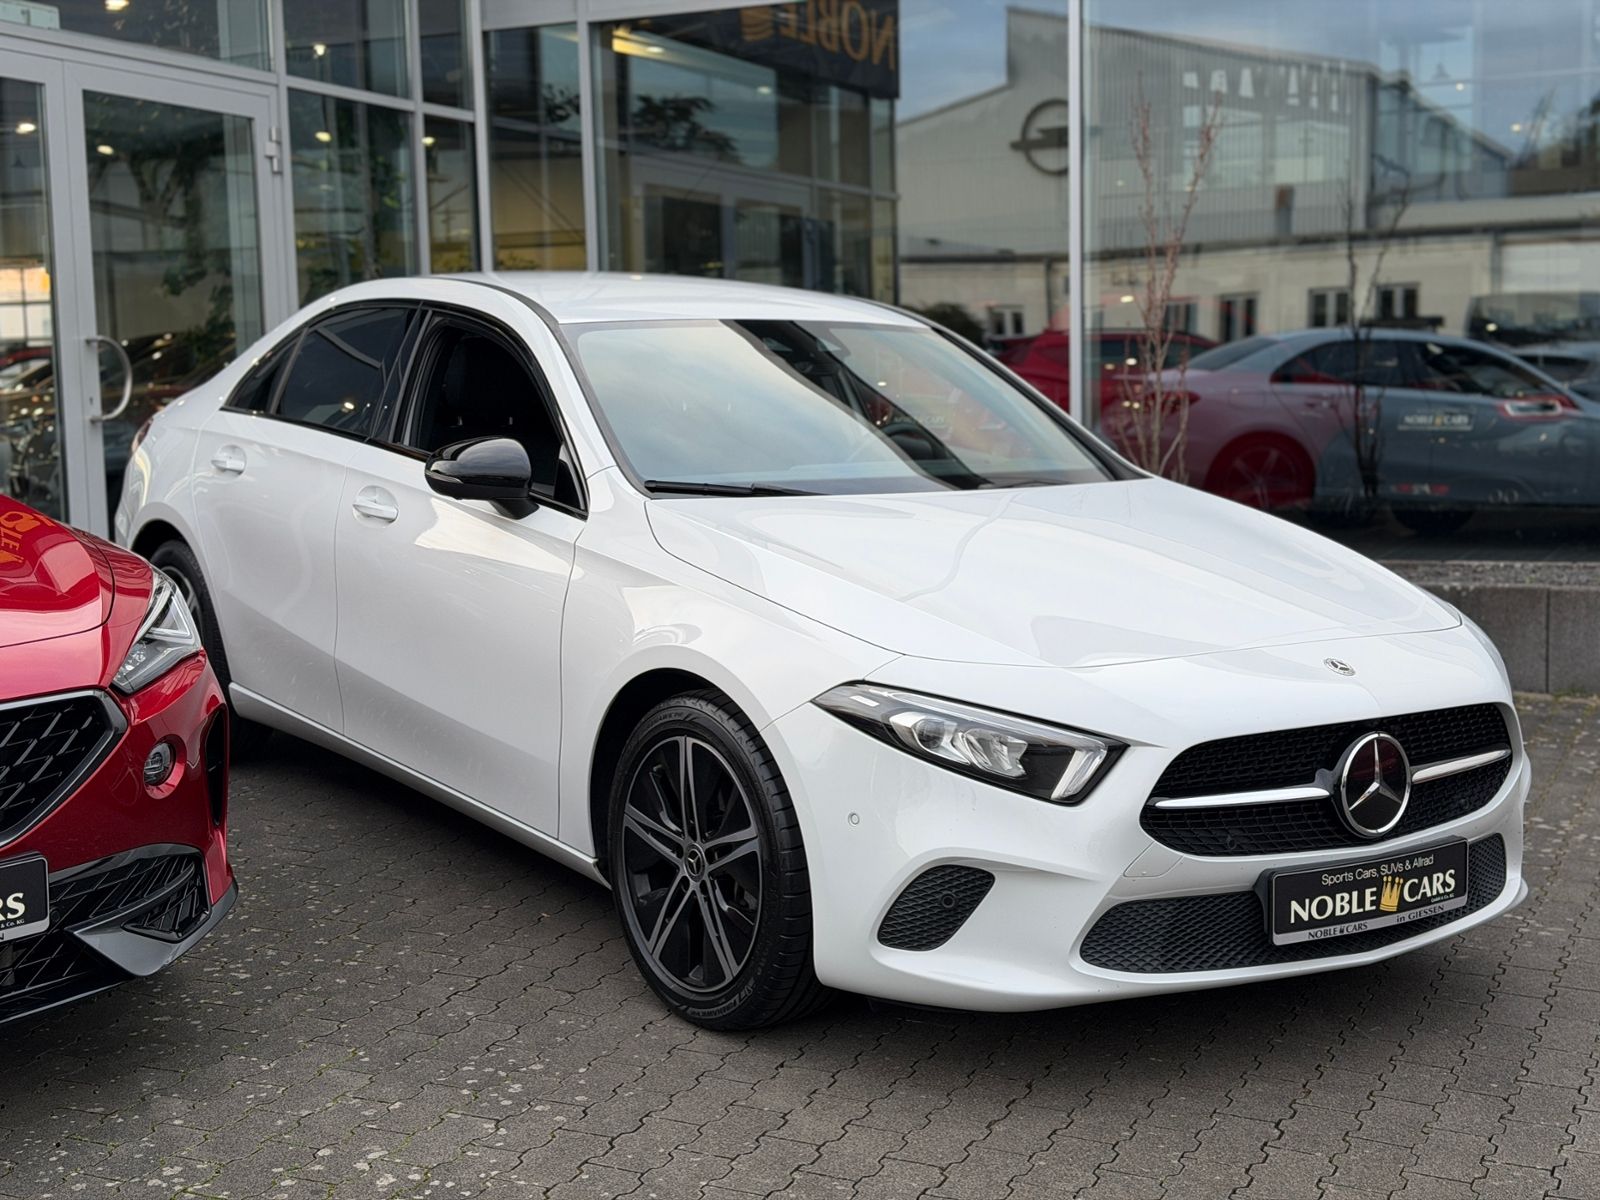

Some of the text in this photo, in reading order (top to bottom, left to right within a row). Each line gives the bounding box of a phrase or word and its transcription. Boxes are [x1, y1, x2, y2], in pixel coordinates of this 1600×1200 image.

[1321, 854, 1434, 886] Sports Cars, SUVs & Allrad
[1289, 869, 1456, 924] NOBLE CARS
[1396, 904, 1445, 923] in GIESSEN
[1308, 921, 1368, 939] NOBLE CARS
